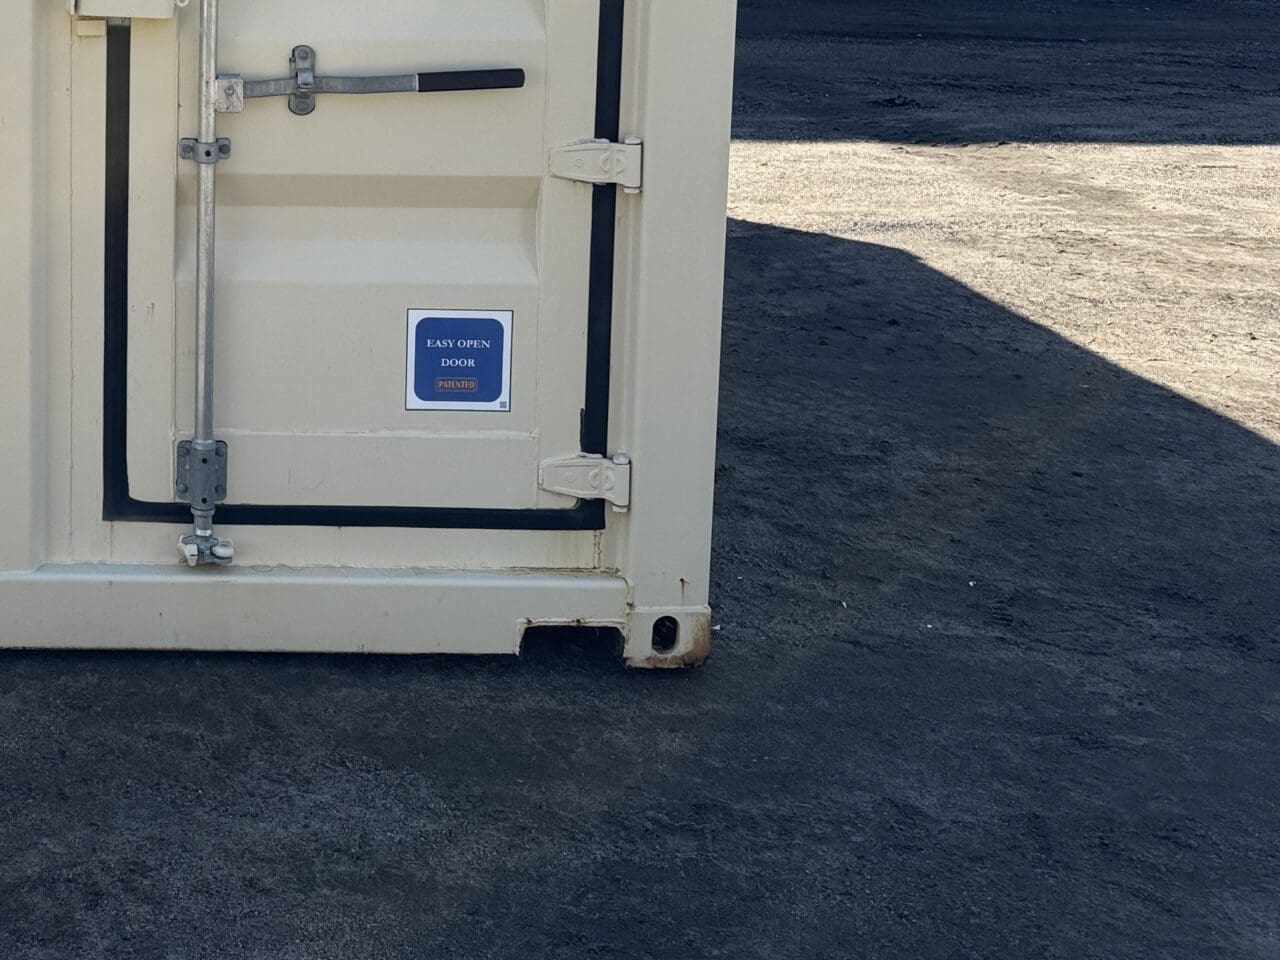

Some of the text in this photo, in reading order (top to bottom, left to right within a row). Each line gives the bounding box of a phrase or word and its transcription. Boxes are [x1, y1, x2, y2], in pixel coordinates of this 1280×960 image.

[427, 339, 490, 348] EASY OPEN
[441, 358, 475, 367] DOOR
